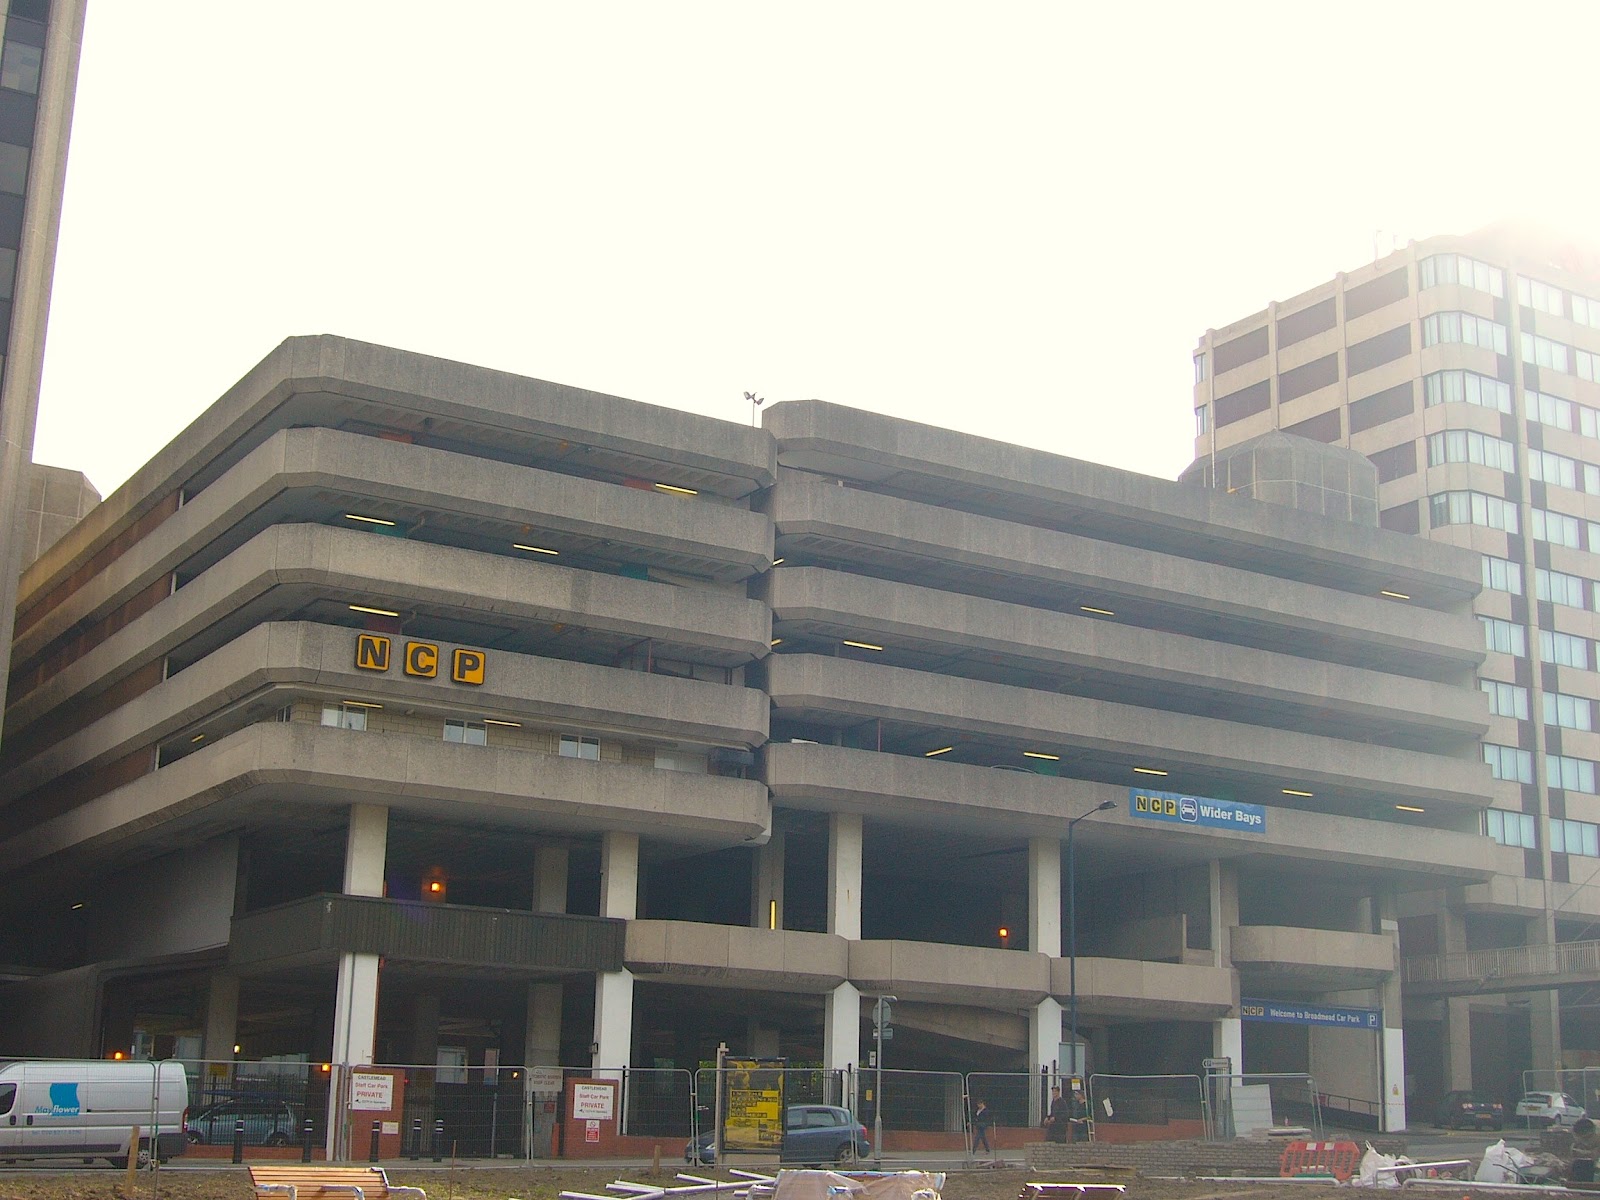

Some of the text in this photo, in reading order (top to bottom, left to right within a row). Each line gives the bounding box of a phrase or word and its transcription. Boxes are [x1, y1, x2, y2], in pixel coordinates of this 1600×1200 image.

[360, 637, 480, 679] NCP
[1136, 796, 1262, 825] NCP Wider Bays
[1242, 1005, 1360, 1023] NCP Welcome to Broadmead Car Park
[35, 1105, 79, 1115] Mayflower
